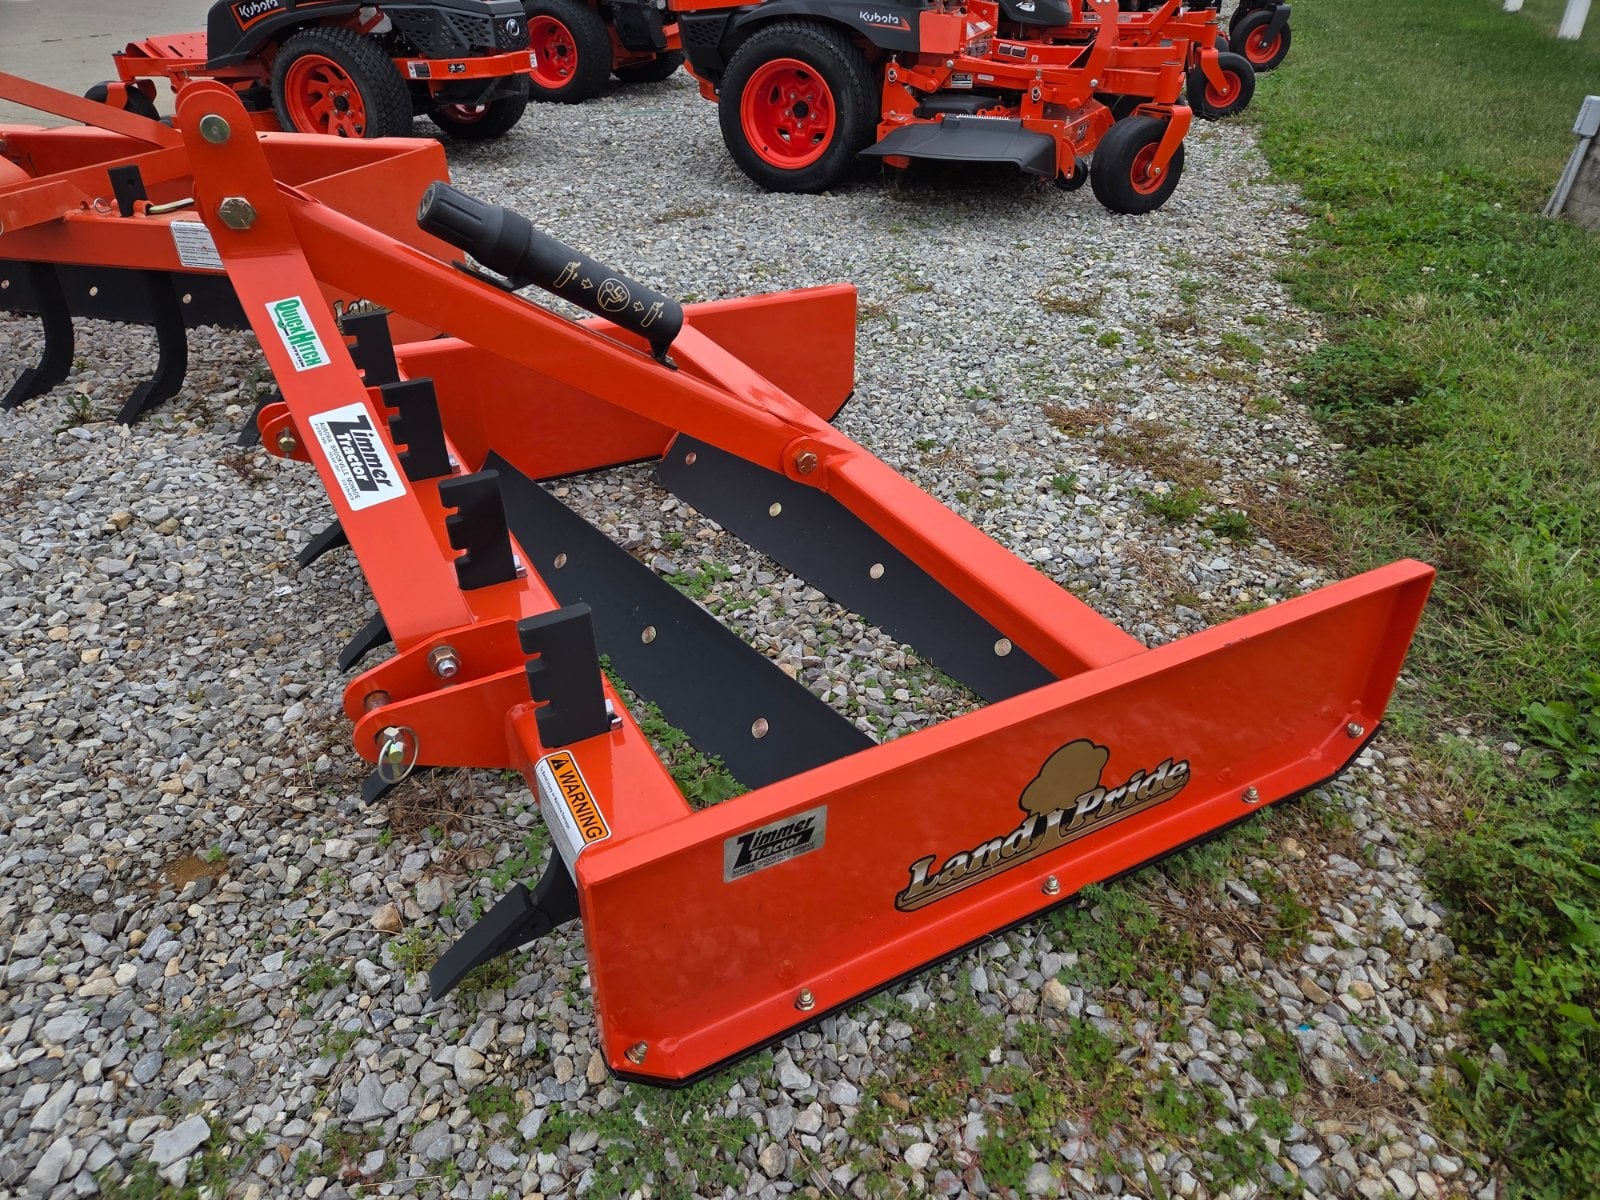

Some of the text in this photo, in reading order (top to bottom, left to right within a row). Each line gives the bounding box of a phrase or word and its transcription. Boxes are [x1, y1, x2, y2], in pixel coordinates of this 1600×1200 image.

[239, 0, 279, 18] Kubota
[860, 11, 899, 24] Kubota
[326, 414, 394, 491] Zimmer
[336, 432, 369, 481] Tractor
[559, 770, 602, 839] WARNING
[901, 757, 1190, 900] Land Pride
[733, 815, 817, 869] Zimmer
[750, 834, 803, 861] Tractor
